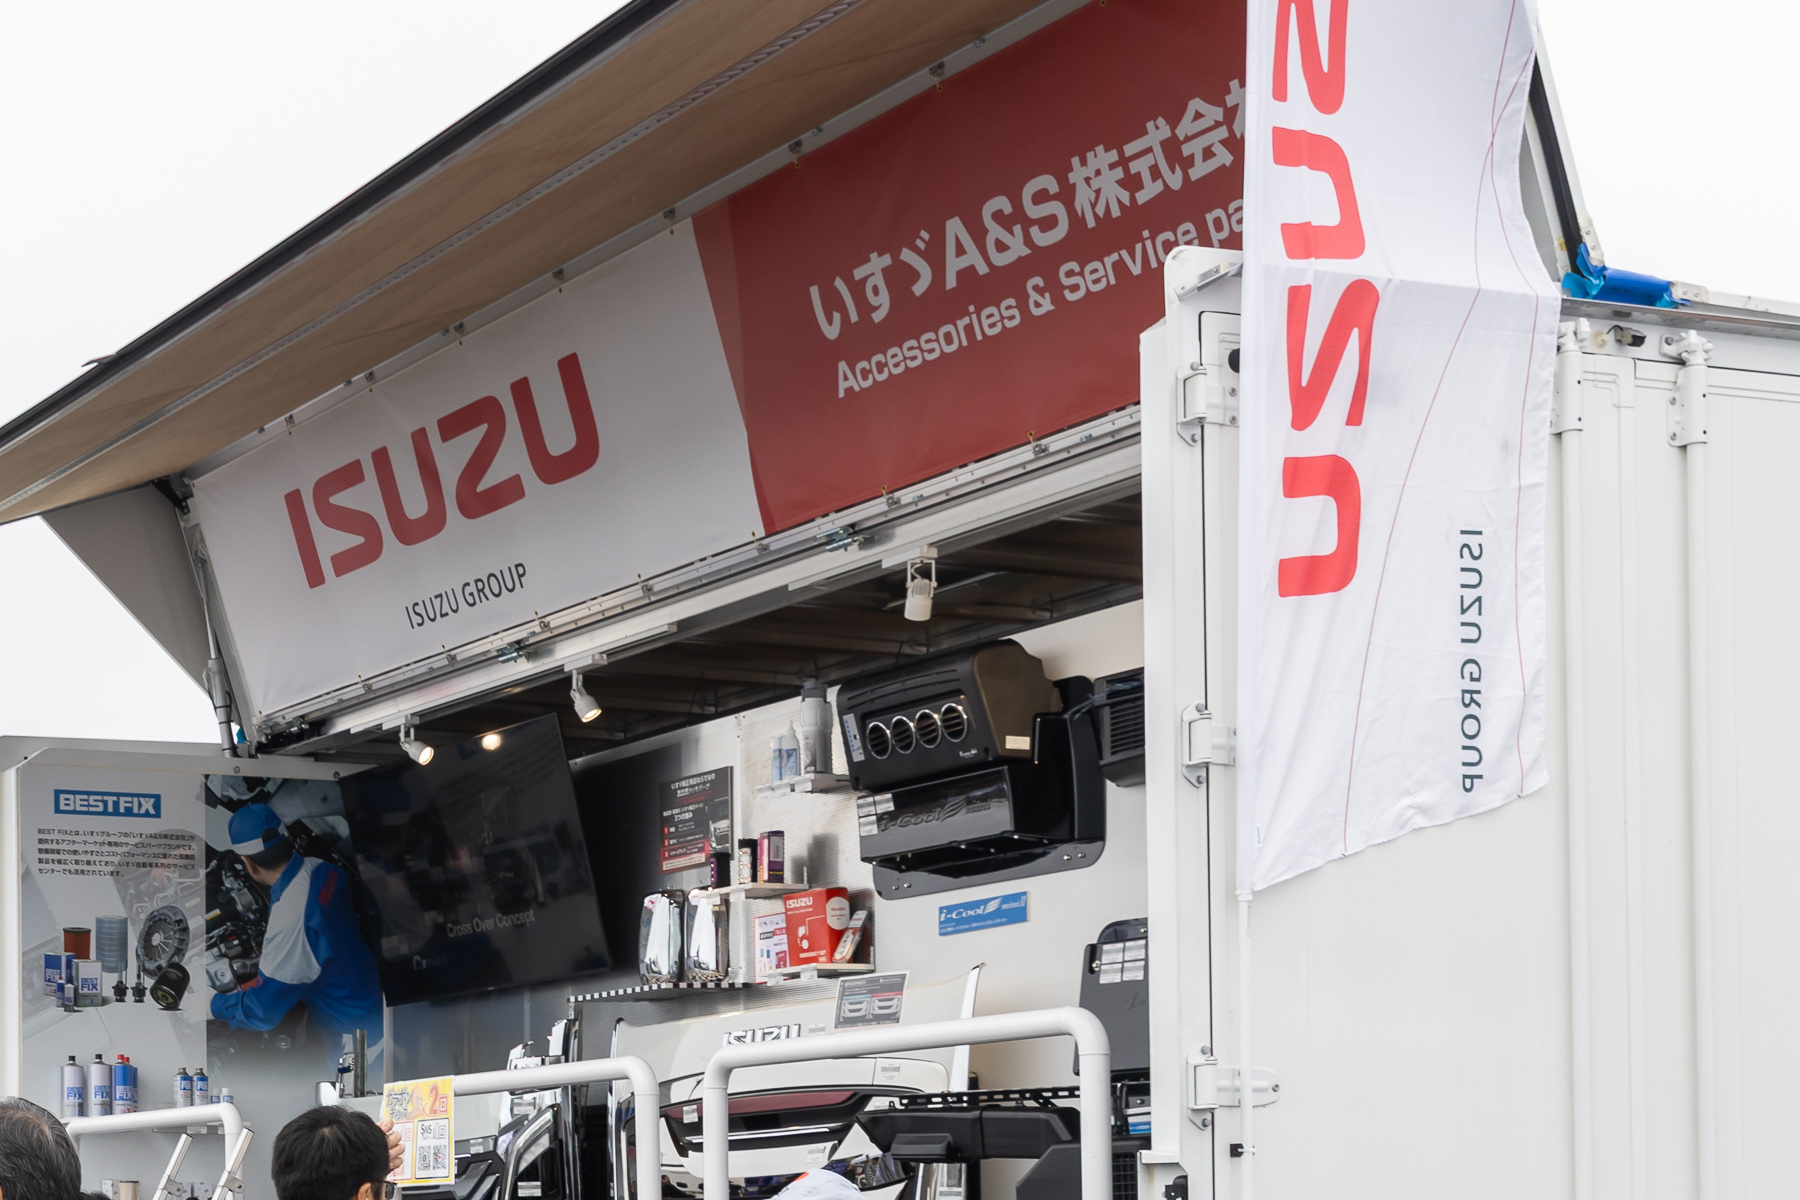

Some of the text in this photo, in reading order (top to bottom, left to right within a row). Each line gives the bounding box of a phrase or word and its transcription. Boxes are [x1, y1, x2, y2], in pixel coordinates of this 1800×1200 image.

[837, 298, 1021, 399] Accessories
[1026, 276, 1055, 317] &
[1059, 221, 1198, 302] Service
[284, 352, 600, 589] ISUZU
[405, 562, 527, 629] ISUZU GROUP
[786, 896, 813, 909] ISUZU
[939, 904, 984, 922] i-Cool
[447, 908, 535, 938] Cross Over Concept
[81, 983, 98, 992] FIX
